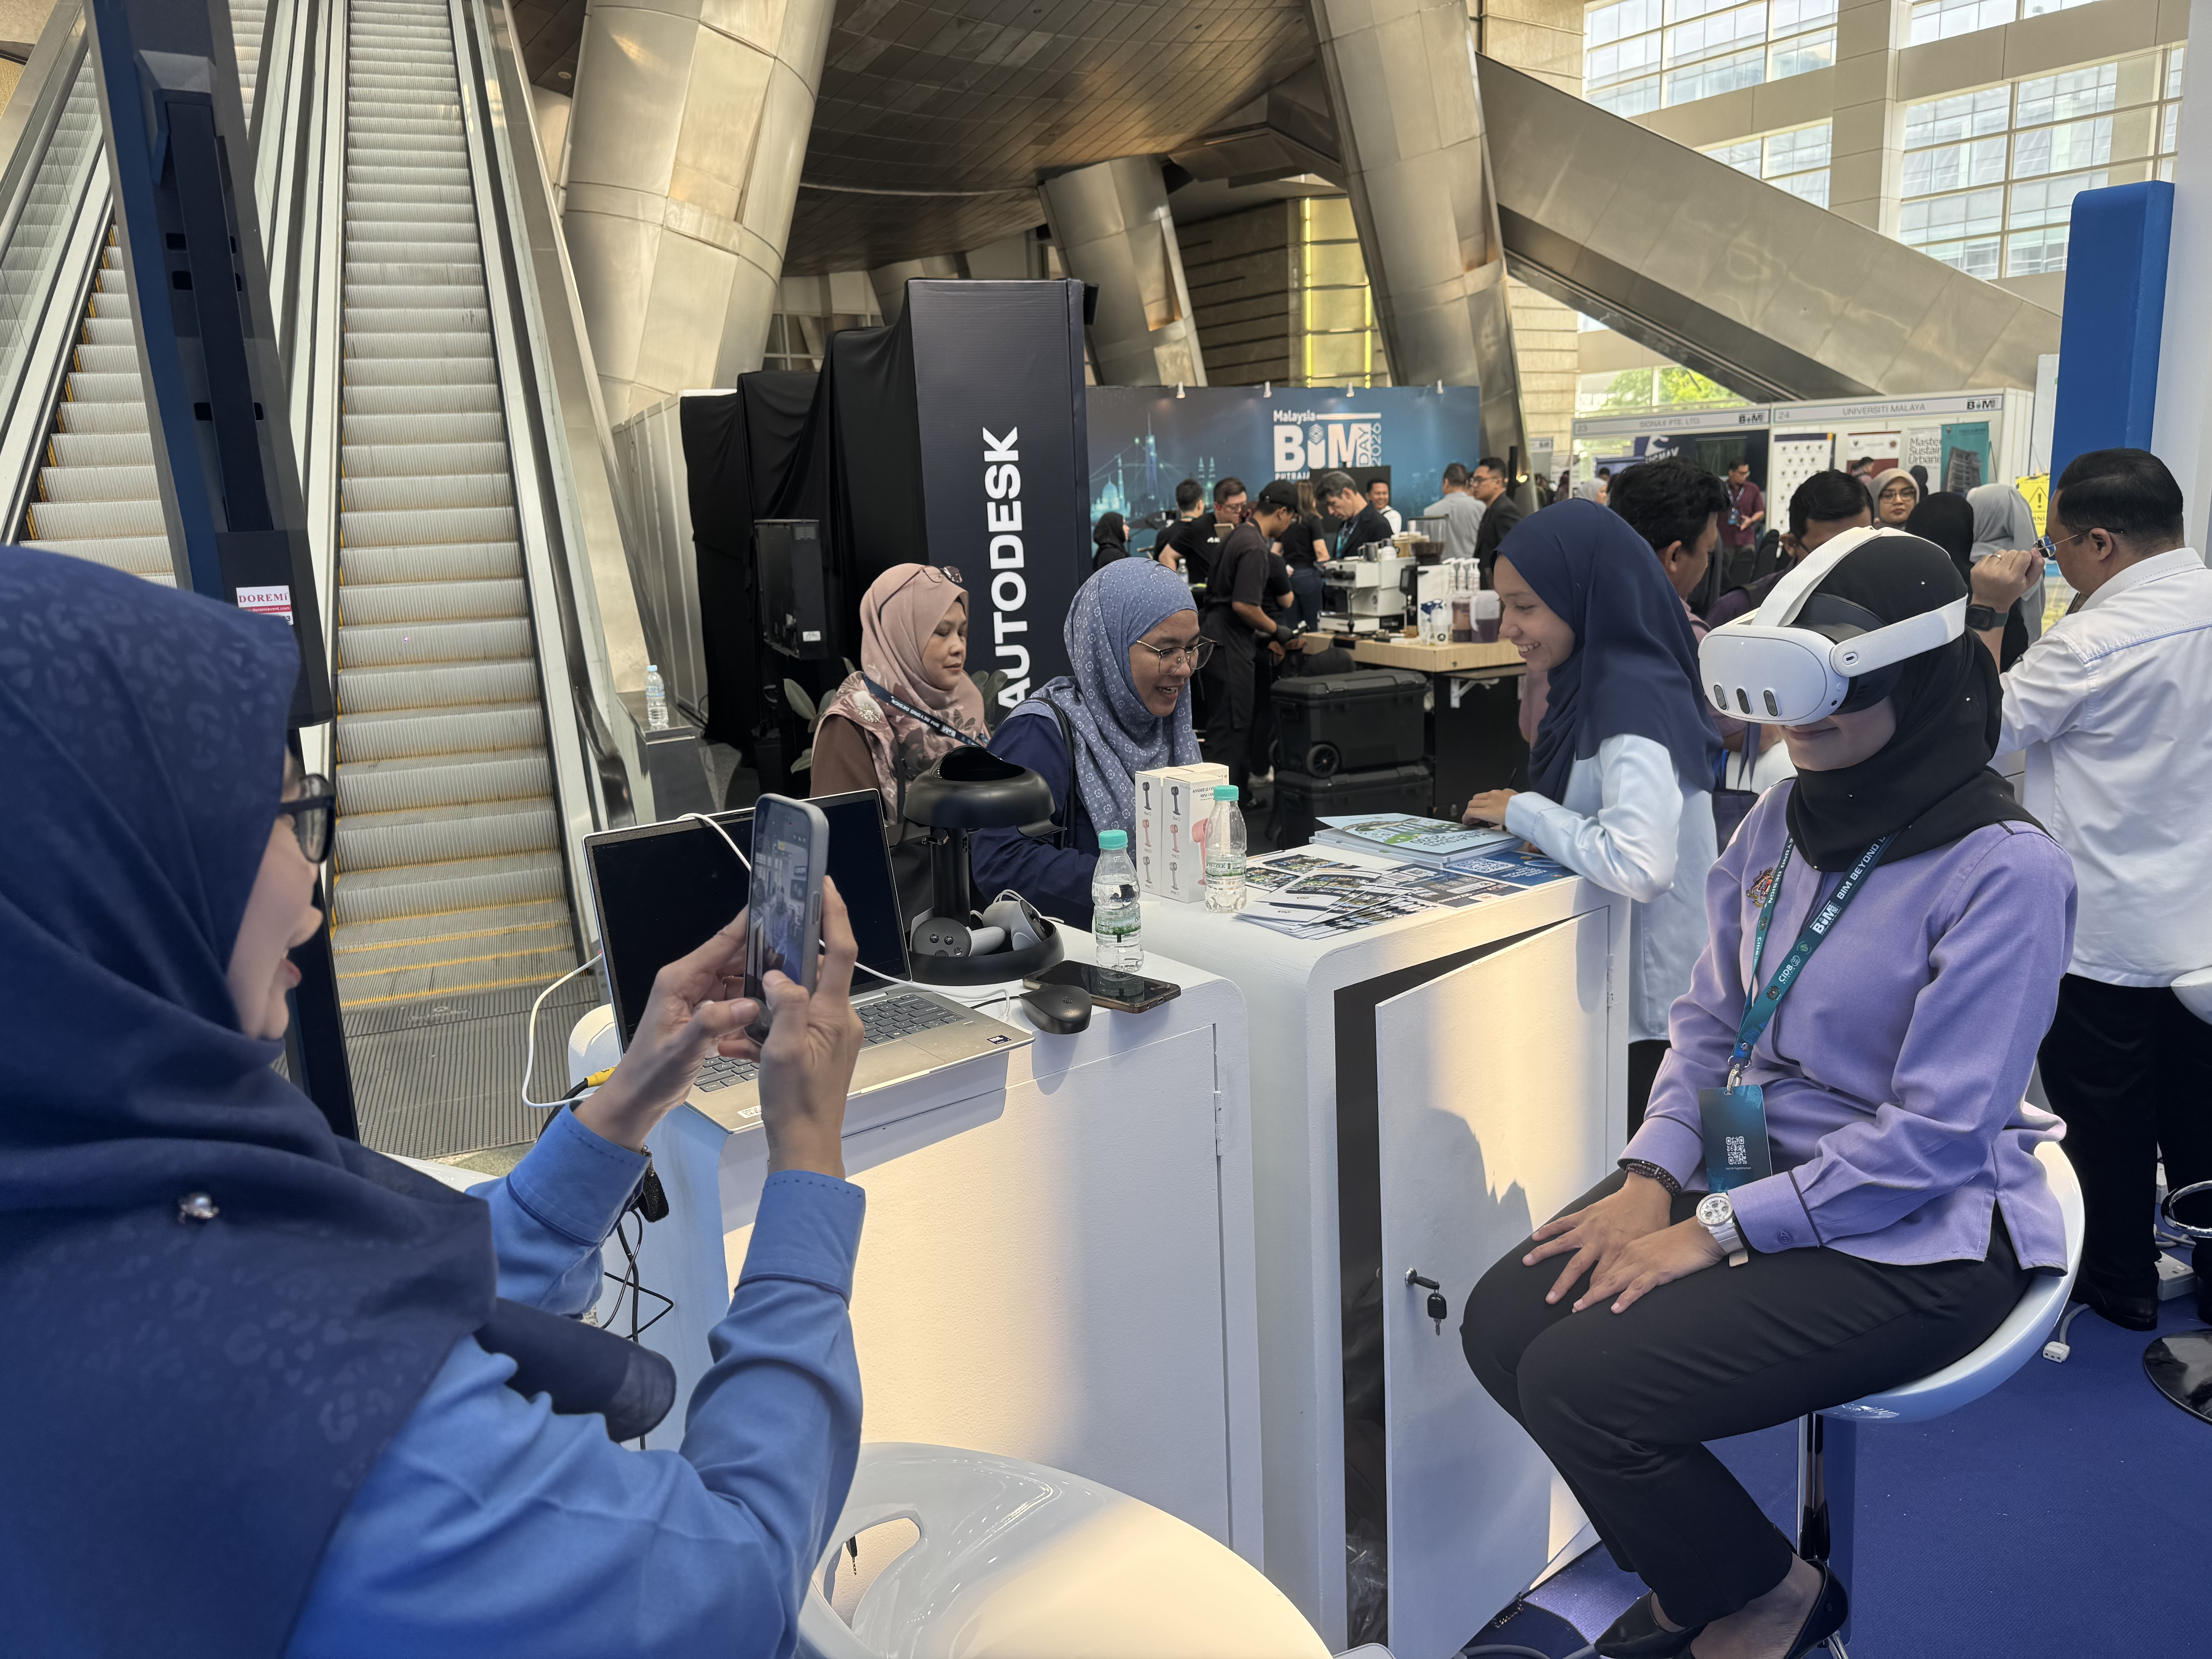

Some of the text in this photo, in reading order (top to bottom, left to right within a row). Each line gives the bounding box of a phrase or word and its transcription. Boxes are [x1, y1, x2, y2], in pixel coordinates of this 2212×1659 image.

[1273, 409, 1316, 425] Malaysia
[1778, 411, 1790, 420] 24
[1843, 403, 1925, 416] UNIVERSITI MALAYA
[1358, 426, 1369, 465] DAY
[1371, 422, 1382, 467] 2026
[982, 426, 1030, 709] AUTODESK
[1768, 838, 1793, 903] EYOND DESIGN
[1836, 843, 1879, 900] BIM BEYOND
[1779, 964, 1793, 982] CIDB
